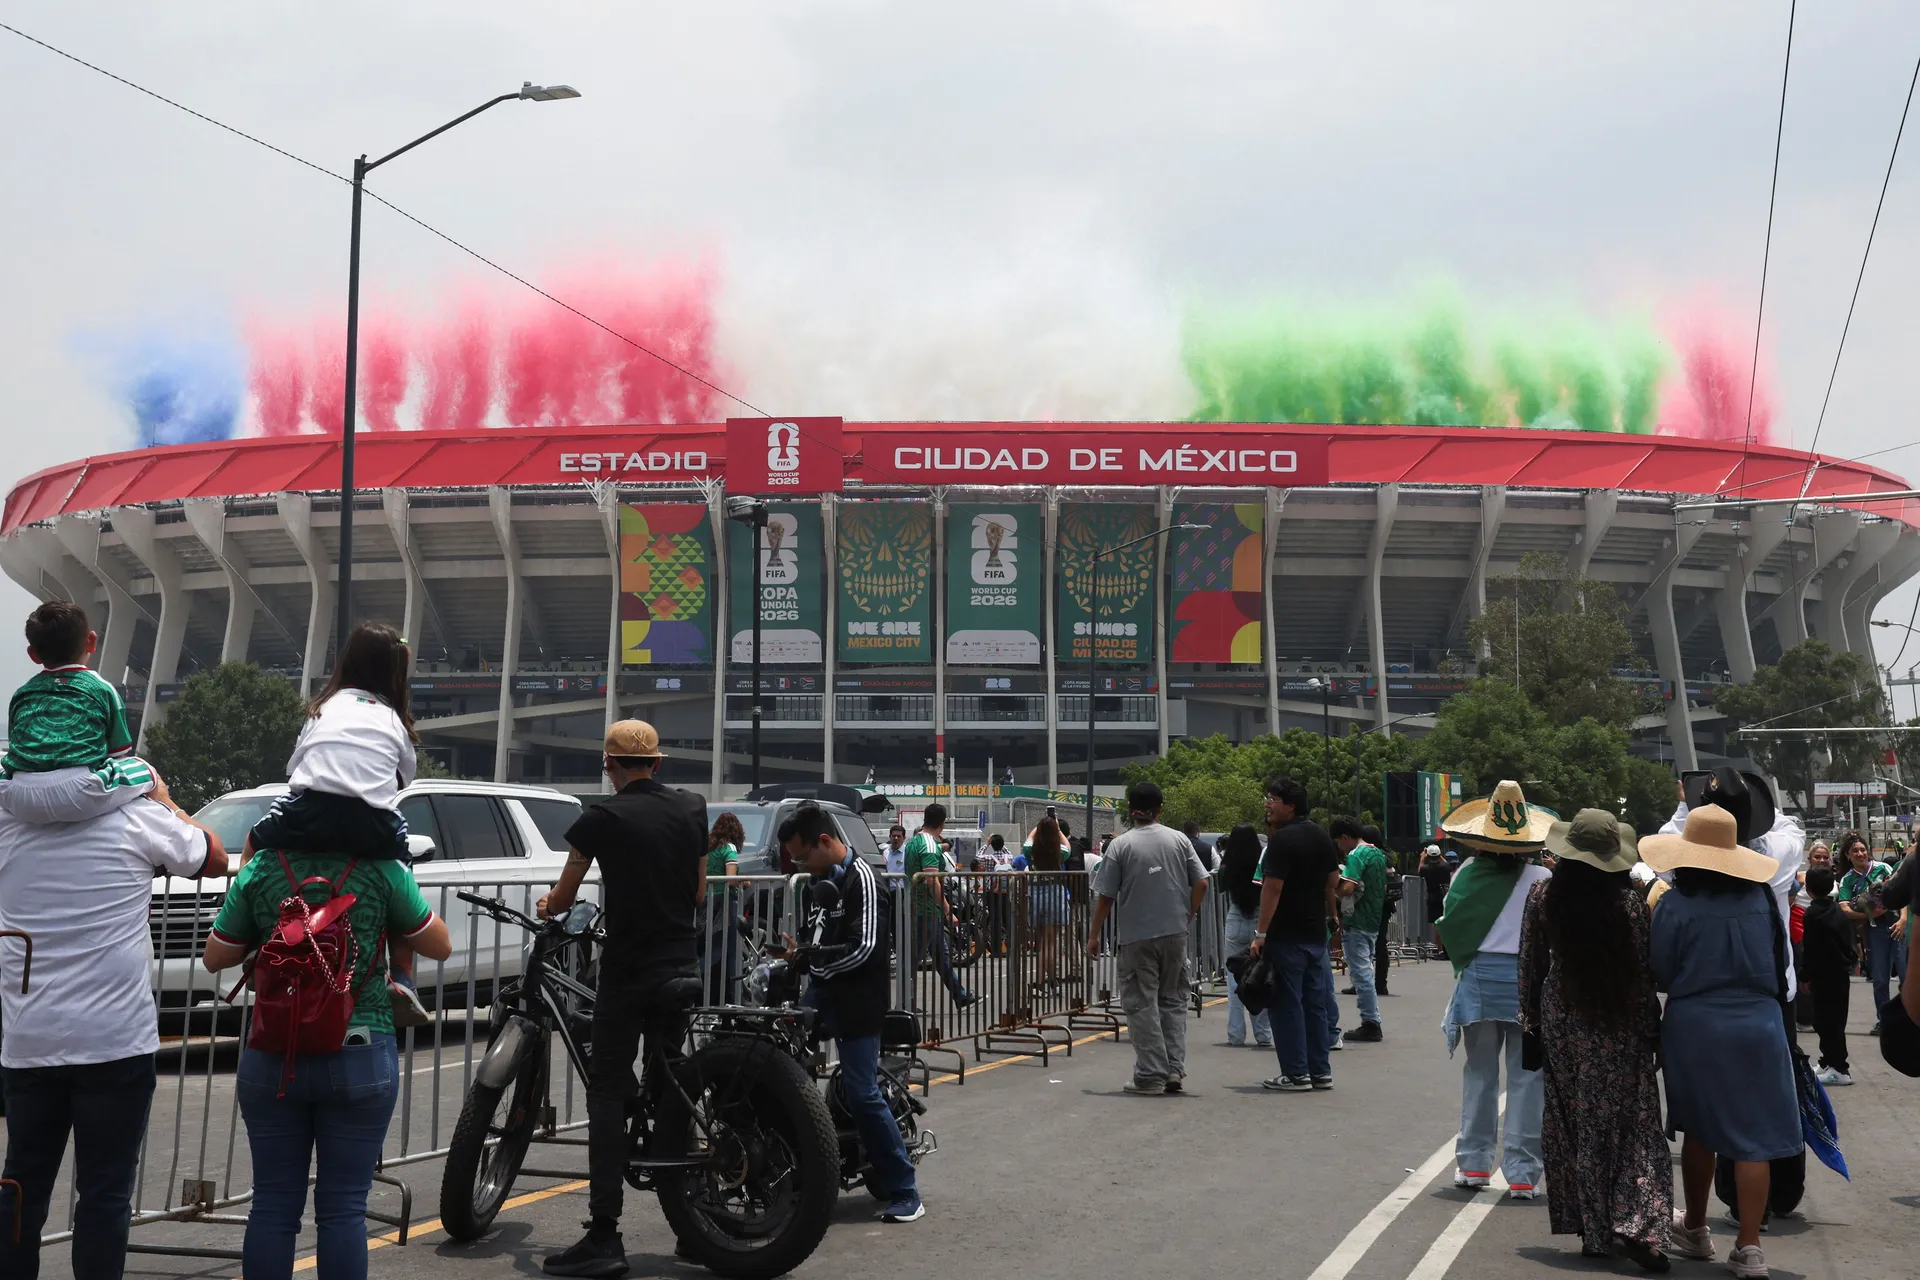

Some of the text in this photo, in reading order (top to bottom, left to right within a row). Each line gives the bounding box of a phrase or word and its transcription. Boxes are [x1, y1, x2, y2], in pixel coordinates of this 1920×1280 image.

[560, 451, 707, 472] ESTADIO
[894, 444, 1297, 472] CIUDAD DE MÉXICO
[767, 477, 800, 485] 2026
[765, 570, 786, 578] FIFA
[984, 570, 1005, 579] FIFA
[760, 587, 799, 600] OPA
[971, 587, 1000, 595] WORLD
[760, 601, 799, 609] UNDIAL
[970, 595, 1018, 606] 2026
[847, 621, 921, 635] WE ARE
[1073, 621, 1138, 636] SOMOS
[847, 637, 920, 648] MEXICO CITY
[1072, 638, 1138, 649] CIUDAD DE
[875, 784, 924, 796] SOMOS
[925, 784, 951, 796] CIUDA
[957, 785, 968, 796] DE
